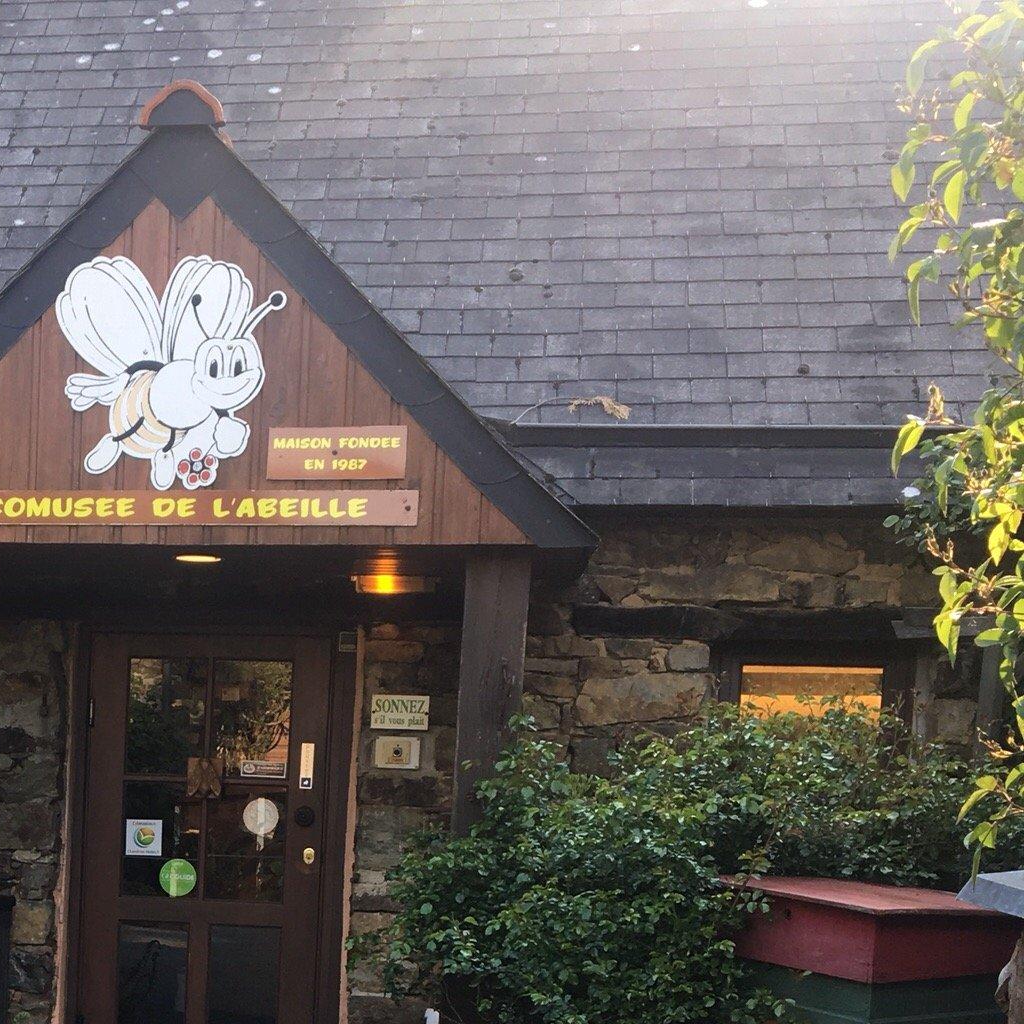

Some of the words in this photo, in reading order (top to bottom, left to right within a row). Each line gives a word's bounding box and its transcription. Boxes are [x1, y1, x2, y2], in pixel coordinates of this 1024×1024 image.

[273, 437, 332, 449] MAISON
[338, 437, 401, 449] FONDEE
[304, 458, 325, 470] EN
[331, 458, 368, 471] 1987
[152, 497, 197, 518] DE
[212, 497, 369, 518] L'ABEILLE
[374, 698, 426, 714] SONNEZ
[388, 718, 405, 726] vous
